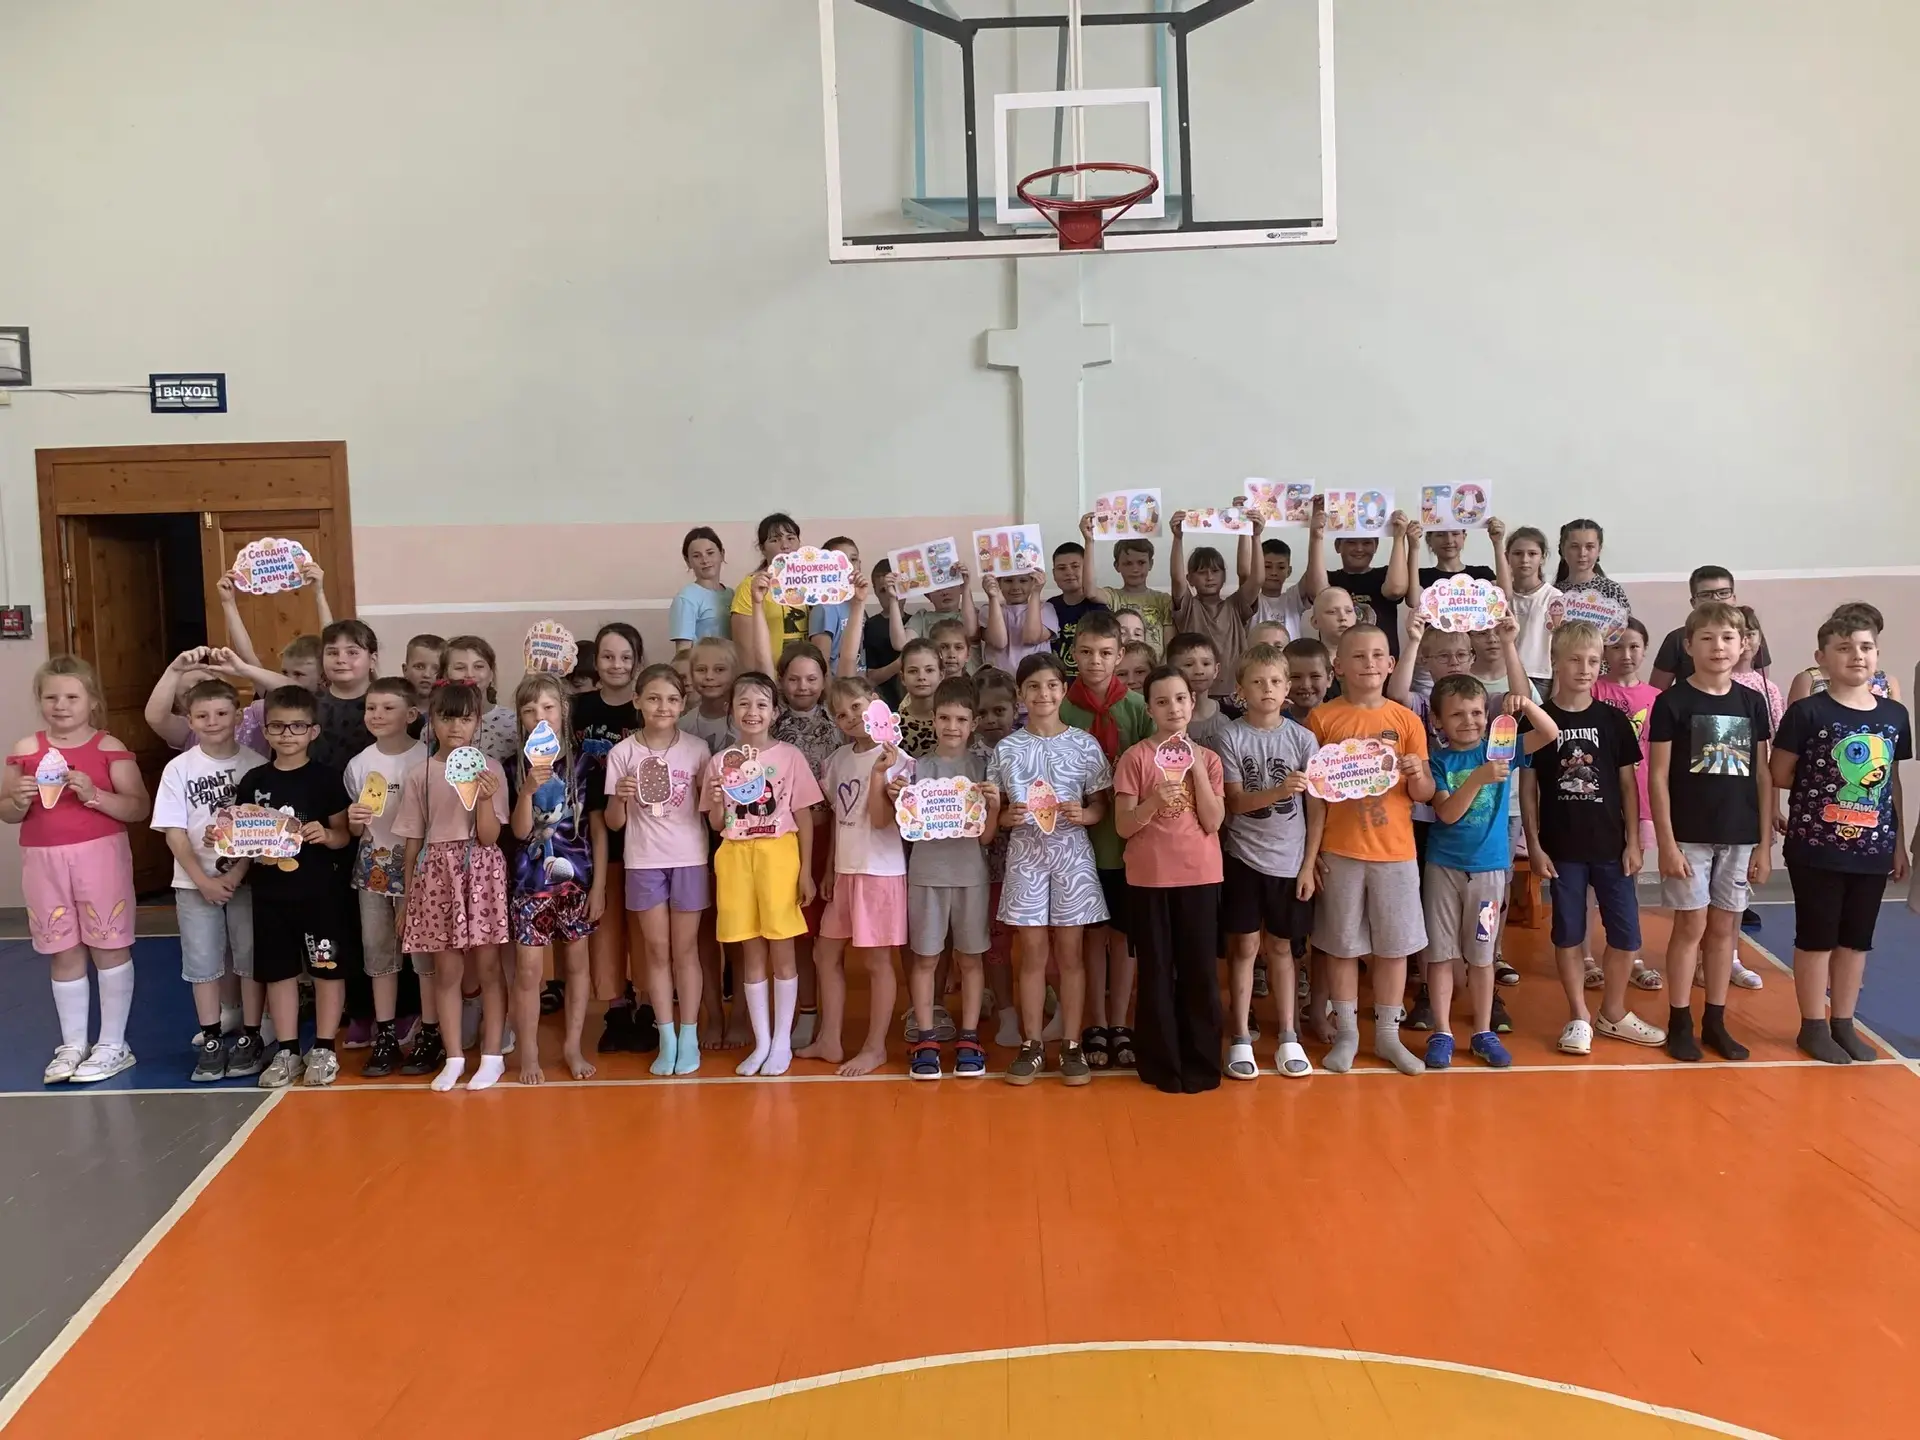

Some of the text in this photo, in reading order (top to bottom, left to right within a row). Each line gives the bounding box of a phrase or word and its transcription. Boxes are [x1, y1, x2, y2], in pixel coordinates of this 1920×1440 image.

[163, 386, 212, 397] ВЫХОД
[248, 546, 290, 559] Сегодня
[255, 555, 287, 567] самый
[252, 561, 295, 576] сладкий
[786, 563, 839, 574] Мороженое
[260, 571, 288, 584] день!
[785, 572, 842, 586] любят все!
[1438, 586, 1486, 597] Сладкий
[1448, 597, 1478, 606] день
[1566, 599, 1617, 615] Мороженое
[1439, 605, 1487, 614] начинается
[1567, 608, 1612, 622] объединяет
[1557, 728, 1599, 752] BOXING
[1341, 761, 1359, 770] как
[1328, 766, 1380, 781] мороженое
[1337, 776, 1372, 789] летом!
[921, 788, 958, 799] Сегодня
[926, 797, 956, 805] можно
[1839, 800, 1874, 812] BRAWL
[921, 804, 963, 815] мечтать
[932, 813, 960, 821] любых
[235, 819, 277, 829] вкусное
[926, 820, 963, 831] вкусах!
[240, 828, 276, 837] летнее
[234, 836, 283, 847] лакомство!
